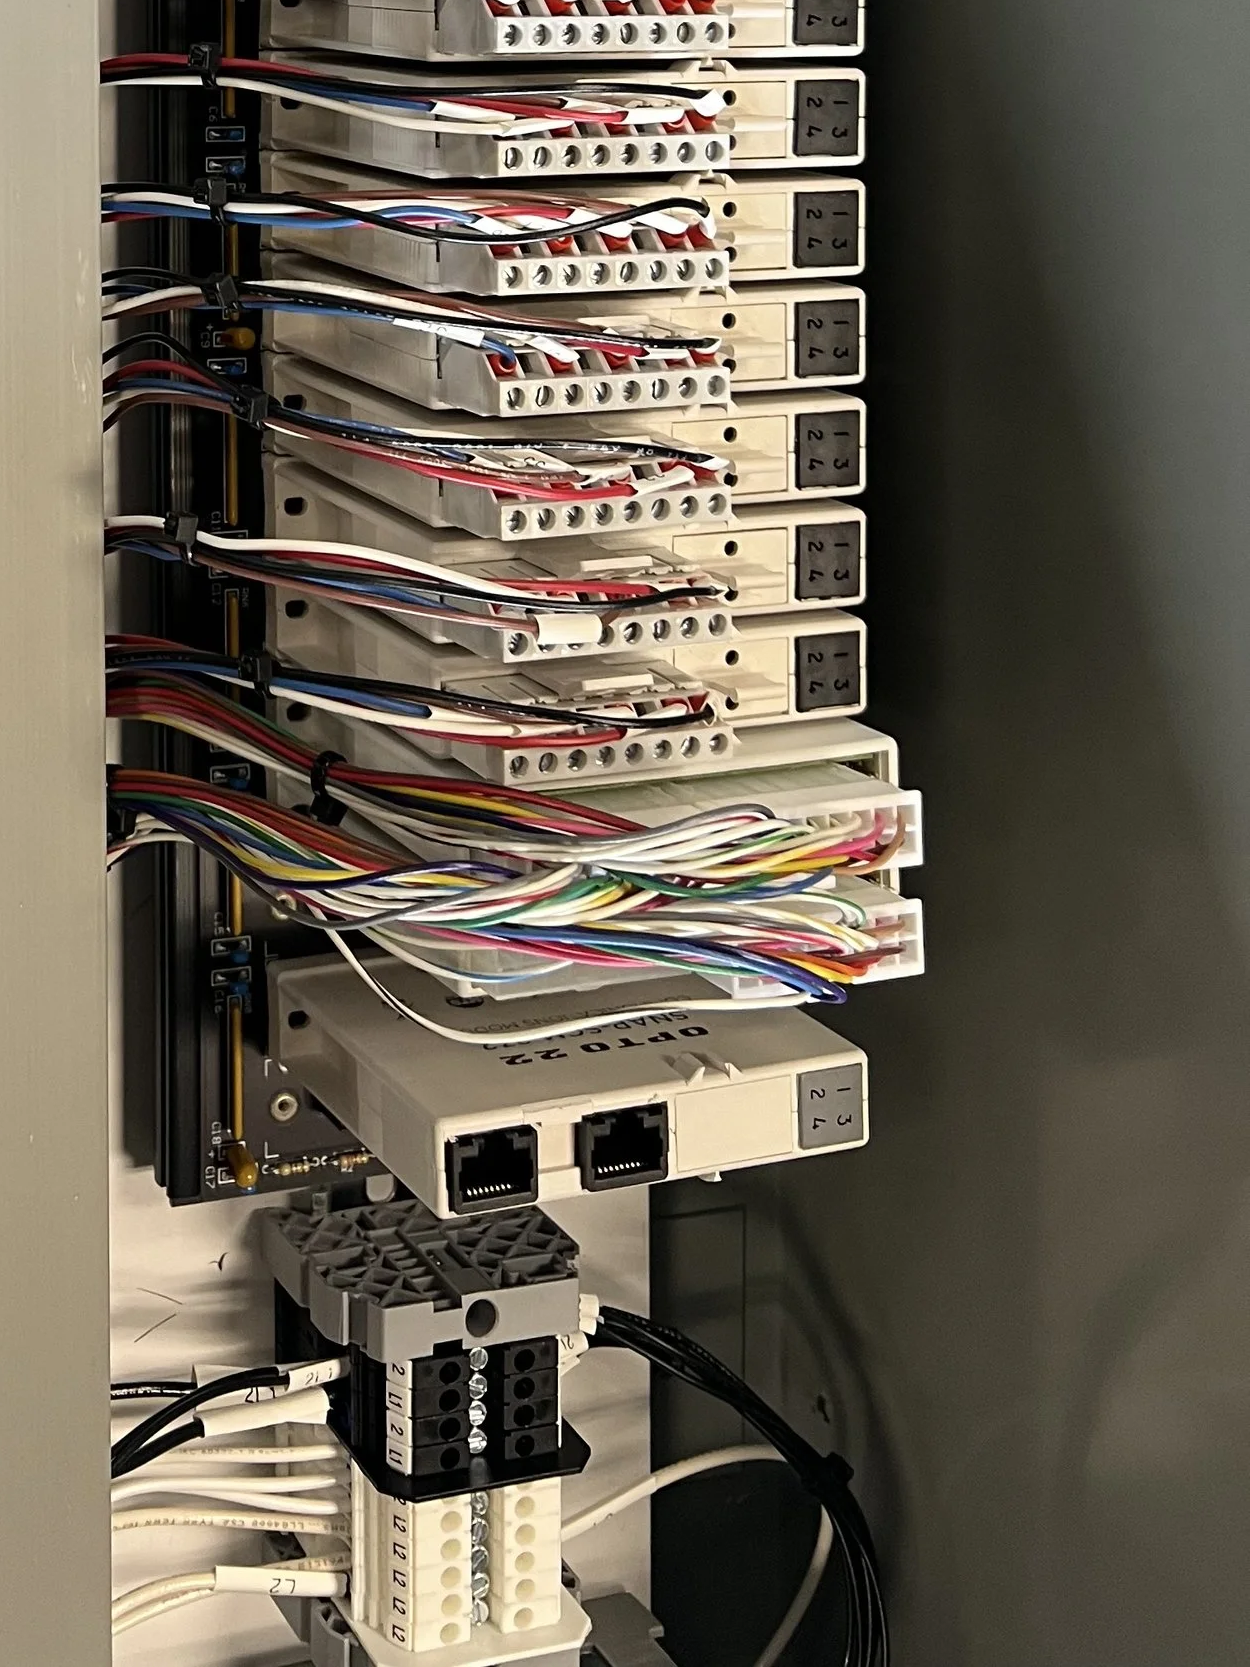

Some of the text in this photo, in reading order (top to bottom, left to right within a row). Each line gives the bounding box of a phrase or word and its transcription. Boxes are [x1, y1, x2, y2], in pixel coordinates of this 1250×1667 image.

[806, 14, 822, 27] 4
[832, 16, 847, 27] 3
[807, 97, 822, 138] 2 4
[832, 127, 848, 138] 3
[807, 208, 822, 249] 2 4
[833, 238, 847, 250] 3
[807, 318, 823, 359] 2 4
[833, 347, 848, 359] 3
[808, 430, 824, 471] 2 4
[834, 458, 849, 470] 3
[808, 541, 824, 582] 2 4
[834, 569, 849, 581] 3
[808, 652, 824, 694] 2 4
[834, 679, 849, 690] 3
[498, 1025, 709, 1067] OPTO 22
[810, 1088, 826, 1130] 2 4
[837, 1114, 852, 1126] 3
[392, 1363, 405, 1376] 2
[388, 1391, 402, 1408] L1
[391, 1423, 403, 1436] 2
[388, 1448, 402, 1465] L1
[393, 1514, 406, 1533] L2
[393, 1542, 406, 1560] L2
[393, 1569, 406, 1588] L2
[393, 1597, 406, 1615] L2
[392, 1624, 405, 1642] L2
